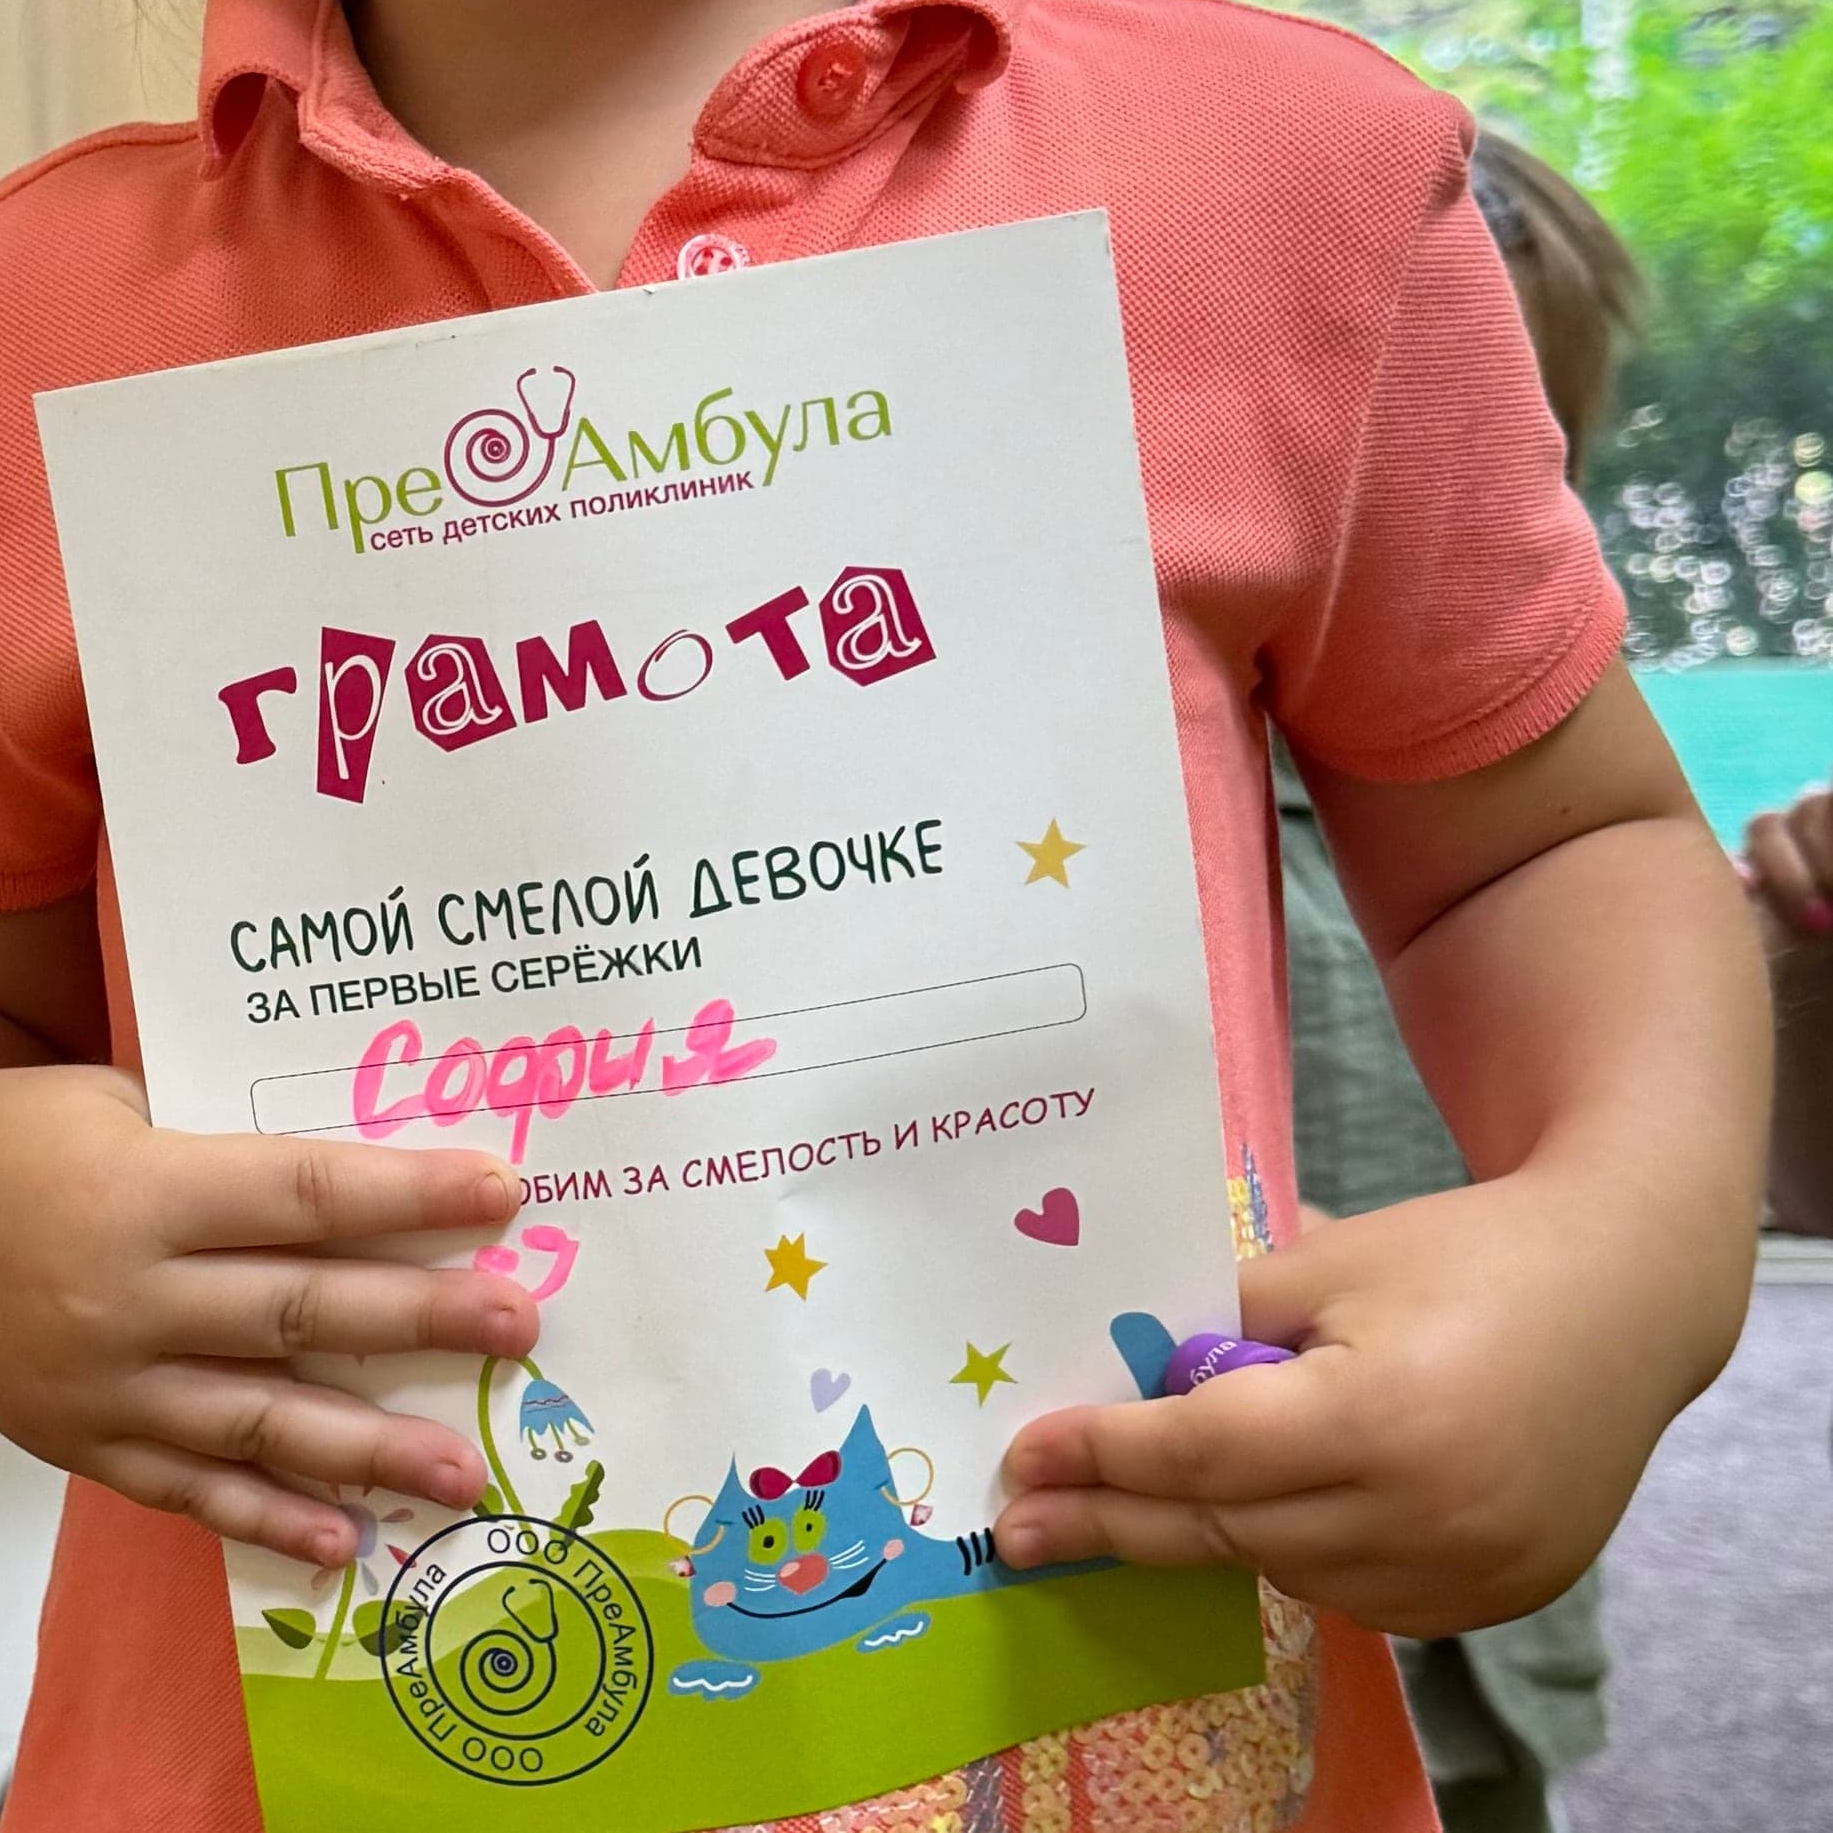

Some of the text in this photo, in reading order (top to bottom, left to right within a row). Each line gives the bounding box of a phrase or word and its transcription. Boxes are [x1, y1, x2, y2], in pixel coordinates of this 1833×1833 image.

[274, 387, 893, 555] ПреАмбула
[369, 470, 755, 553] сеть детских поликлиник
[230, 819, 943, 972] САМОЙ СМЕЛОЙ ДЕВОЧКЕ
[247, 936, 702, 1024] ЗА ПЕРВЫЕ СЕРЁЖКИ
[623, 1162, 669, 1195] ЗА
[682, 1130, 881, 1188] СМЕЛОСТЬ
[893, 1121, 919, 1152] И
[931, 1087, 1096, 1141] КРАСОТУ
[1190, 1339, 1238, 1387] була
[396, 1563, 457, 1742] ПреАмбула
[487, 1528, 638, 1737] ООО ПреАмбула
